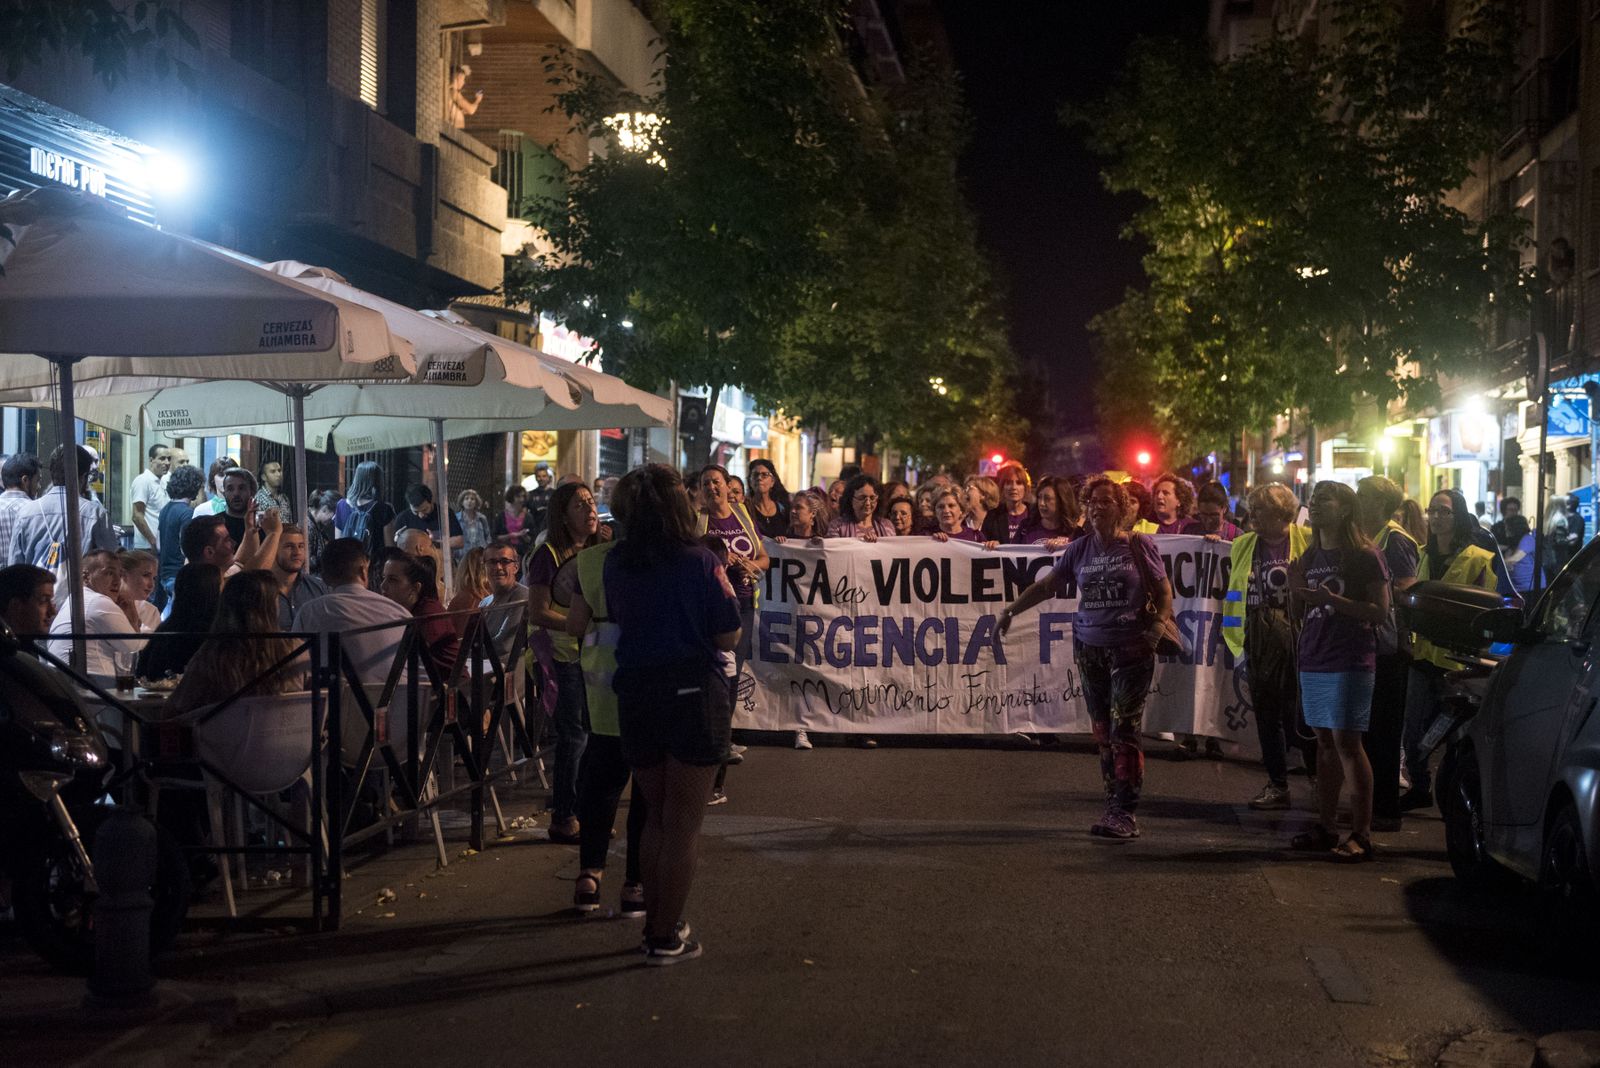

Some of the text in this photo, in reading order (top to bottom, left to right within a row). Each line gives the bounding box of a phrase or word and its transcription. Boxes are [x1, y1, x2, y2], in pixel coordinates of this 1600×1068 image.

[262, 319, 313, 334] CERVEZAS
[258, 334, 317, 348] ALHAMBRA
[427, 361, 466, 371] CERVEZAS
[423, 371, 468, 382] ALHAMBRA
[833, 575, 870, 604] las
[960, 670, 1051, 714] Feminista
